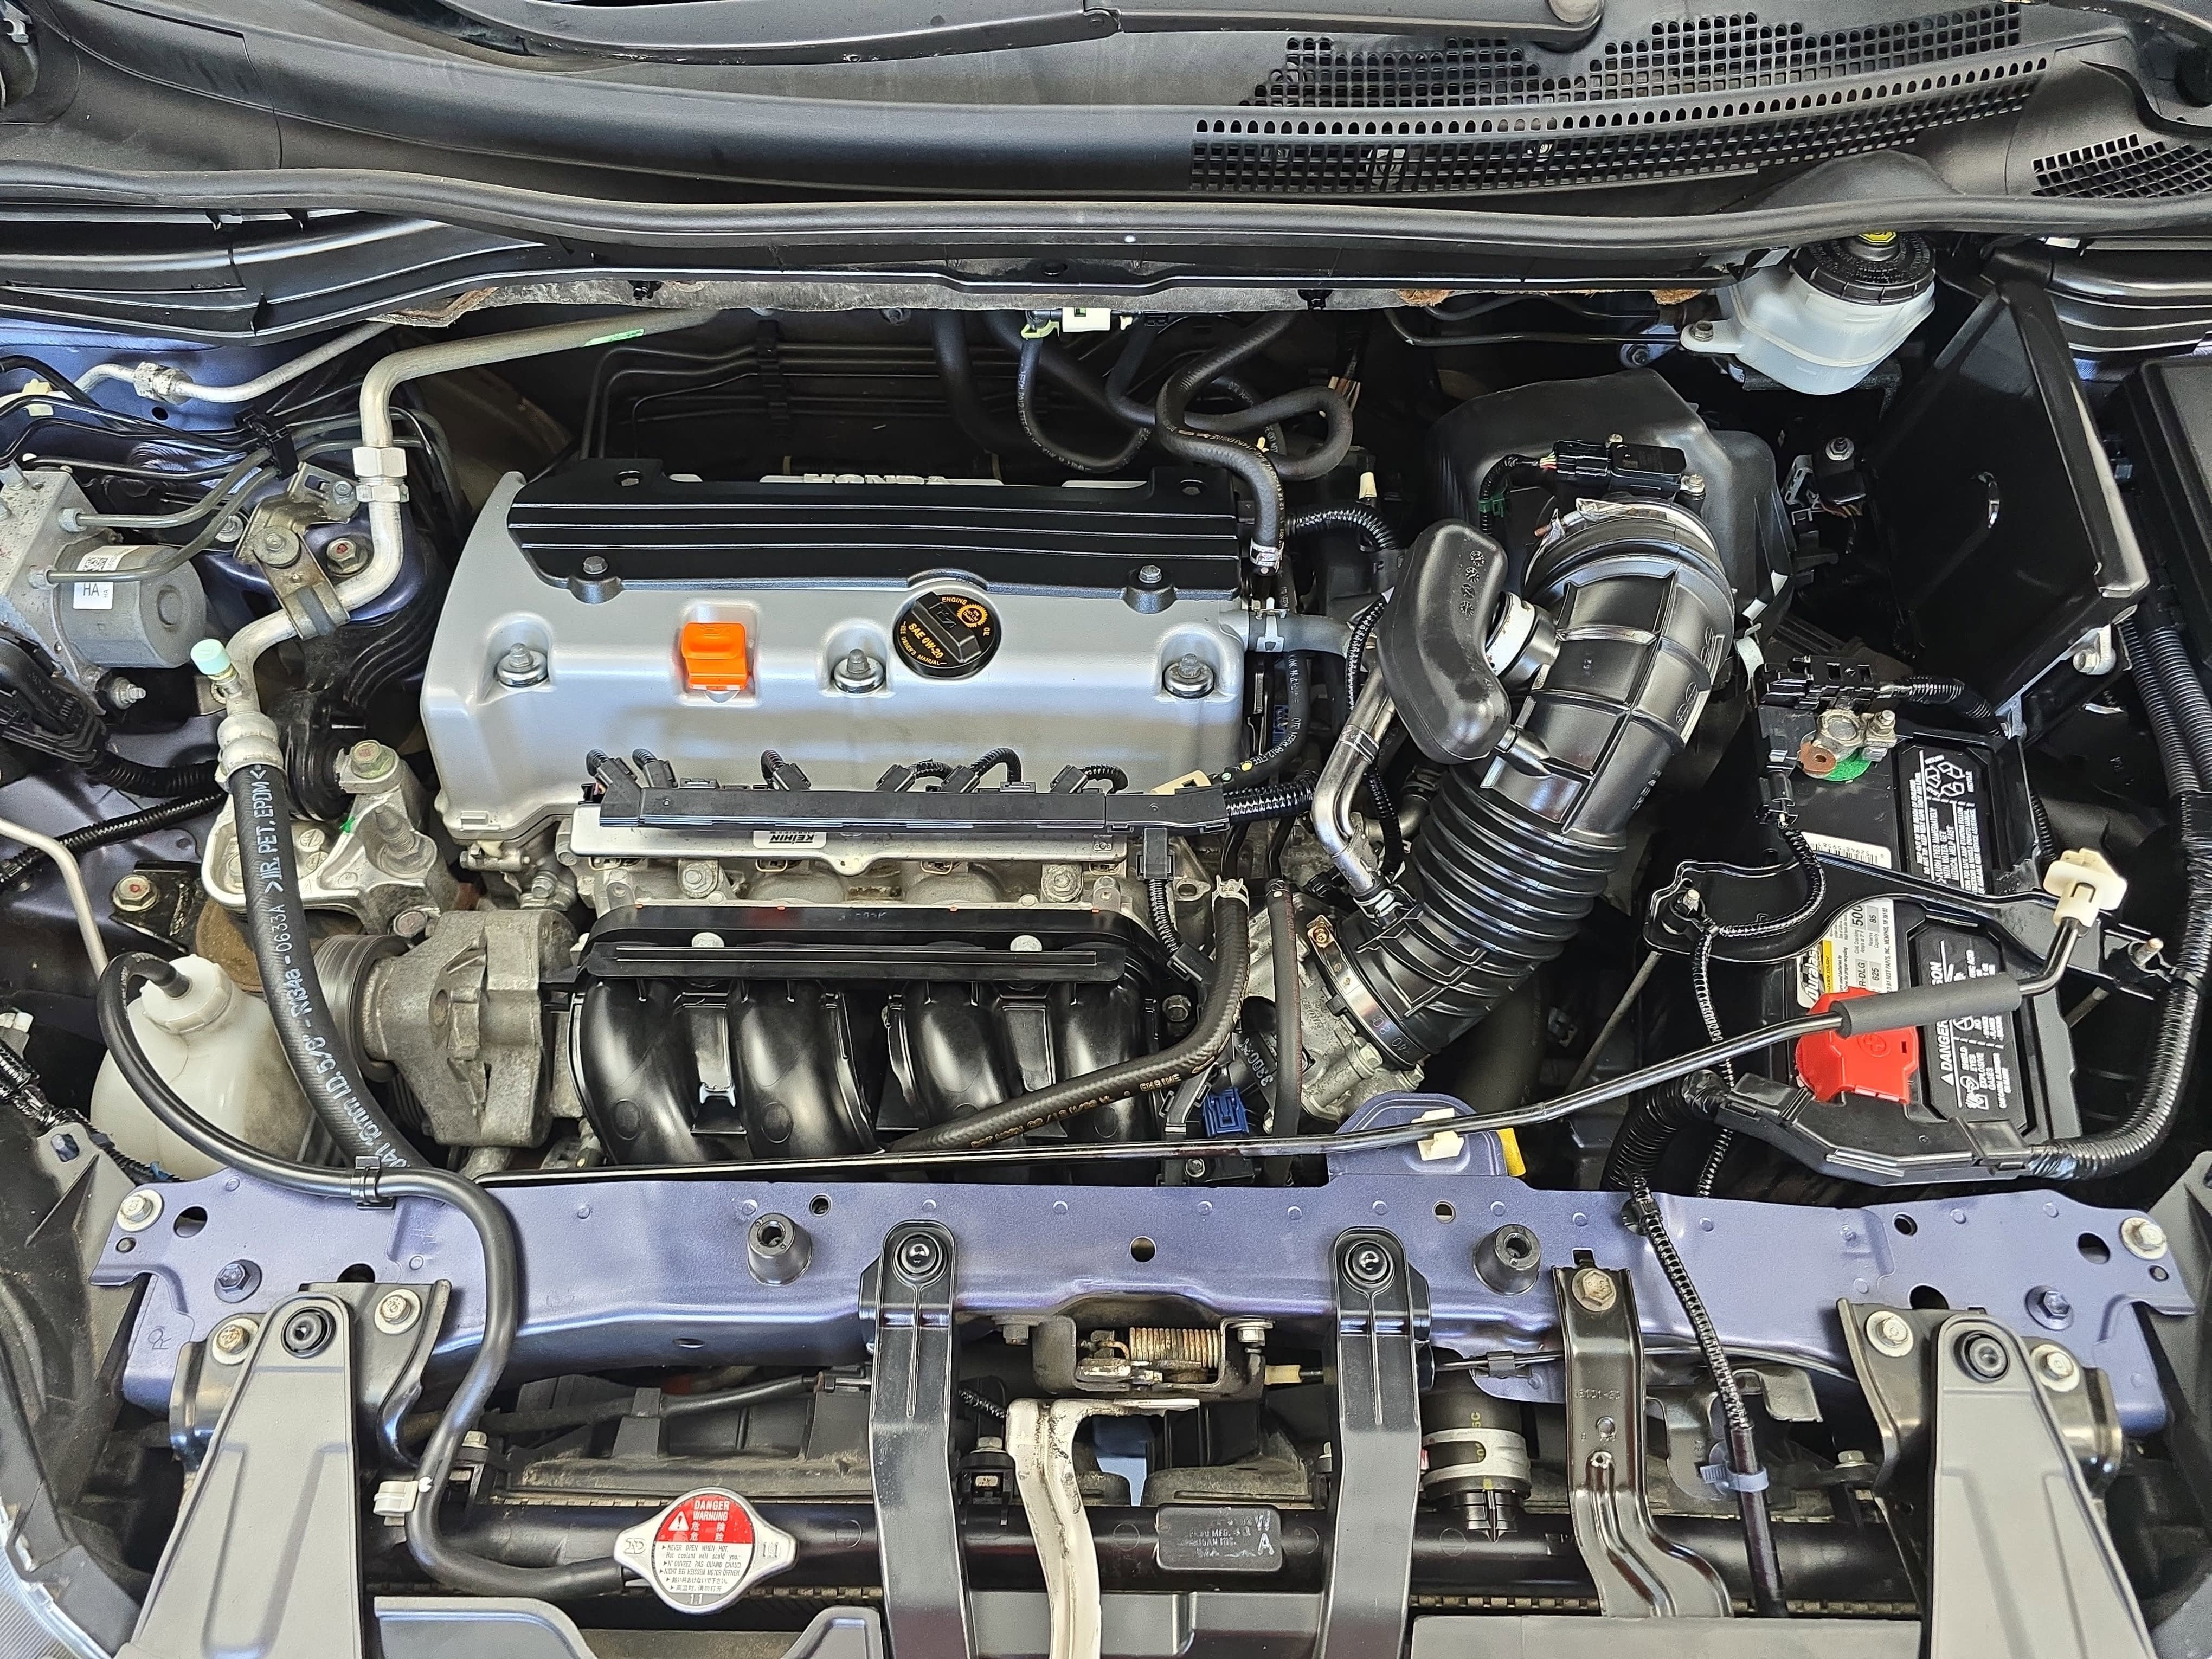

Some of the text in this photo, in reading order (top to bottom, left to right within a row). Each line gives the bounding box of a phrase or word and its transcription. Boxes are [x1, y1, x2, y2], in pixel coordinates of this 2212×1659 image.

[83, 583, 99, 596] HA
[942, 596, 991, 636] ENGINE OIL
[901, 636, 917, 655] OWNER'S
[917, 654, 941, 665] MANUAL
[908, 623, 944, 659] SAE 0W-20
[769, 834, 815, 844] KEIHIN
[1929, 807, 1943, 877] FLUSH EYES IMMEDIATELY
[1939, 829, 1947, 842] GET
[1946, 824, 1959, 880] MEDICAL HELP FAST
[1943, 864, 1951, 878] WITH
[1851, 905, 1863, 926] 500
[1869, 914, 1876, 923] 85
[269, 904, 293, 952] 0633A
[285, 969, 313, 1017] R134a
[1973, 1018, 1982, 1030] NO
[302, 1034, 336, 1074] 5/8"
[1935, 1019, 1953, 1071] DANGER
[1959, 1046, 1969, 1070] SHIELD
[1968, 1053, 1977, 1071] EYES
[1976, 1052, 1988, 1089] EXPLOSIVE
[1986, 1066, 1996, 1090] GASES
[326, 1071, 351, 1099] I.D.
[344, 1096, 382, 1146] 16mm
[693, 1511, 728, 1521] WARNUNG
[694, 1500, 730, 1510] DANGER
[1257, 1533, 1275, 1555] A
